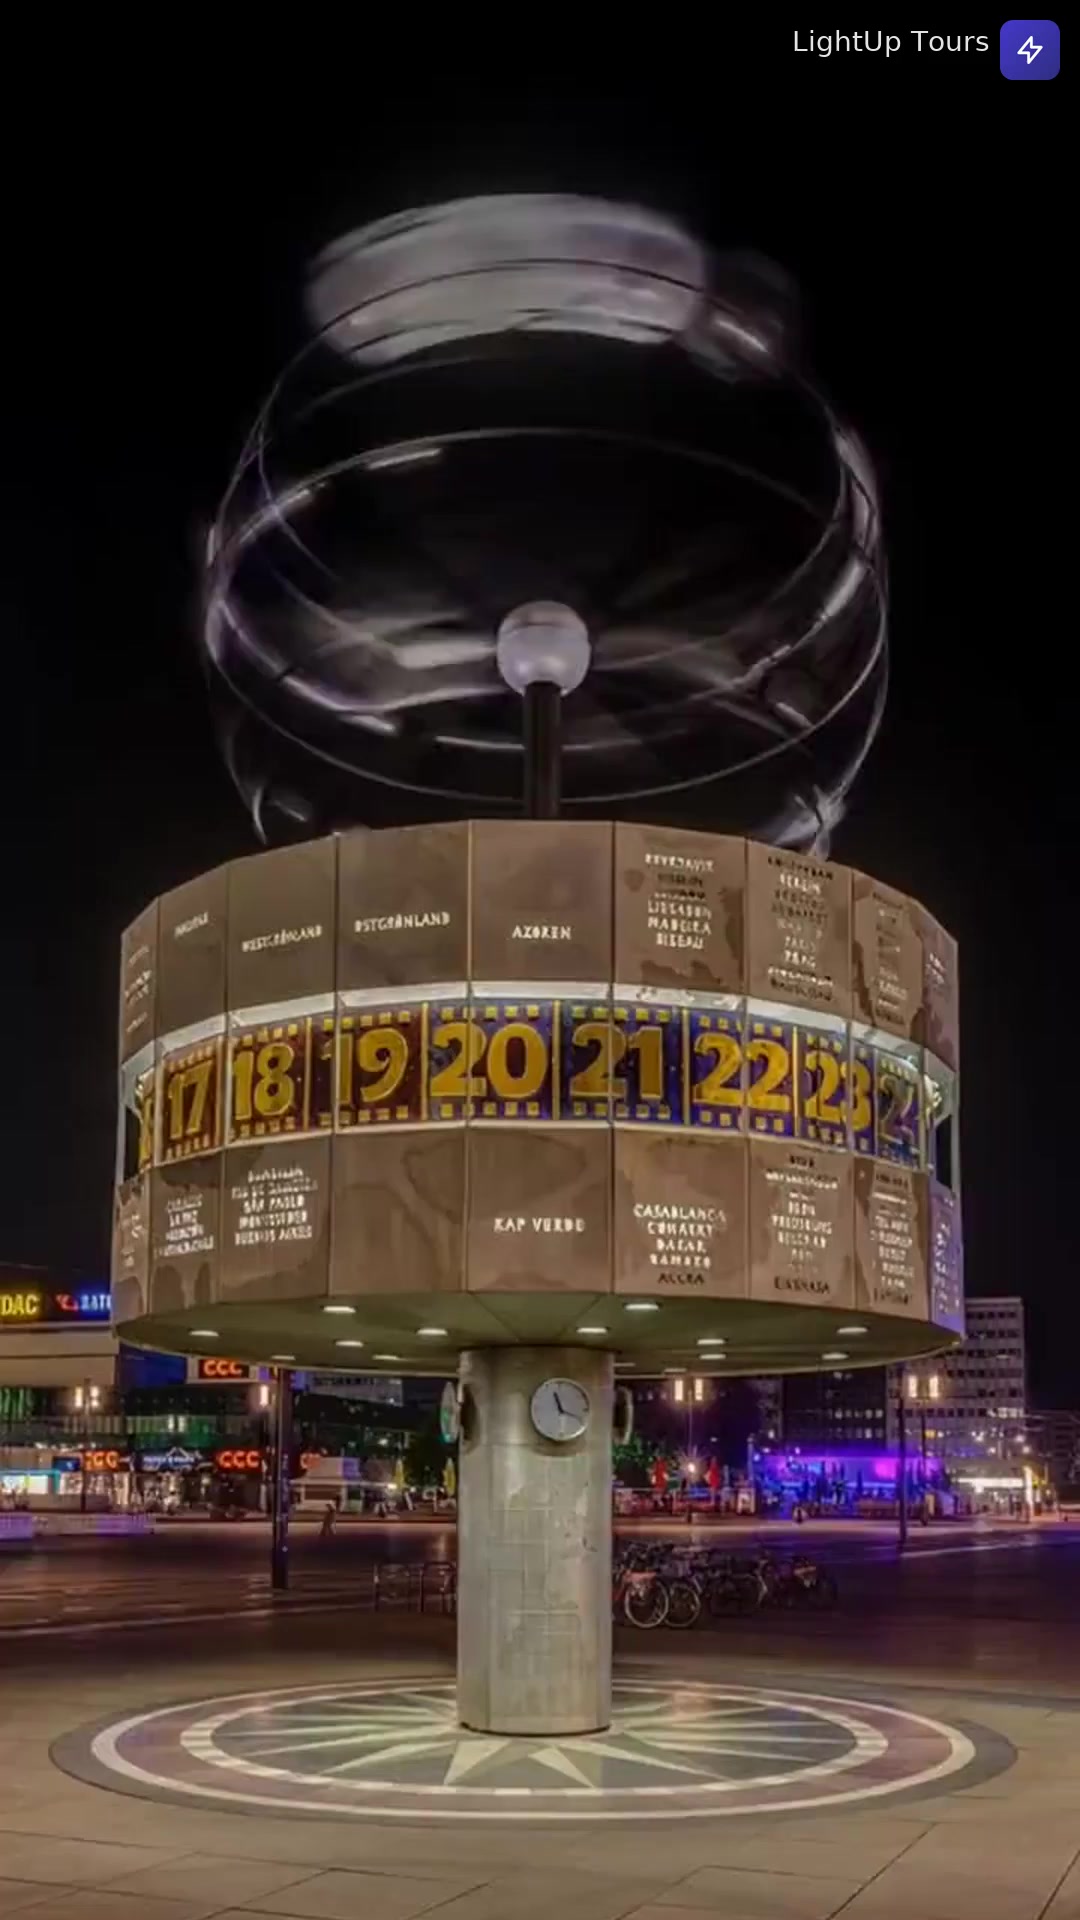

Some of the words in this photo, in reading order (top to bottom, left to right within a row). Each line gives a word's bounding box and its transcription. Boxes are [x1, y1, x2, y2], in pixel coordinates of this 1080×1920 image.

[512, 925, 572, 941] AZOREN
[168, 1060, 212, 1141] 17
[233, 1042, 295, 1121] 18
[321, 1027, 409, 1105] 19
[431, 1022, 548, 1099] 20
[569, 1023, 663, 1100] 21
[693, 1032, 791, 1112] 22
[805, 1050, 872, 1132] 23
[633, 1203, 727, 1222] CASABLANCA
[493, 1217, 526, 1233] KAP
[203, 1359, 242, 1377] CCC
[219, 1451, 260, 1469] CCC
